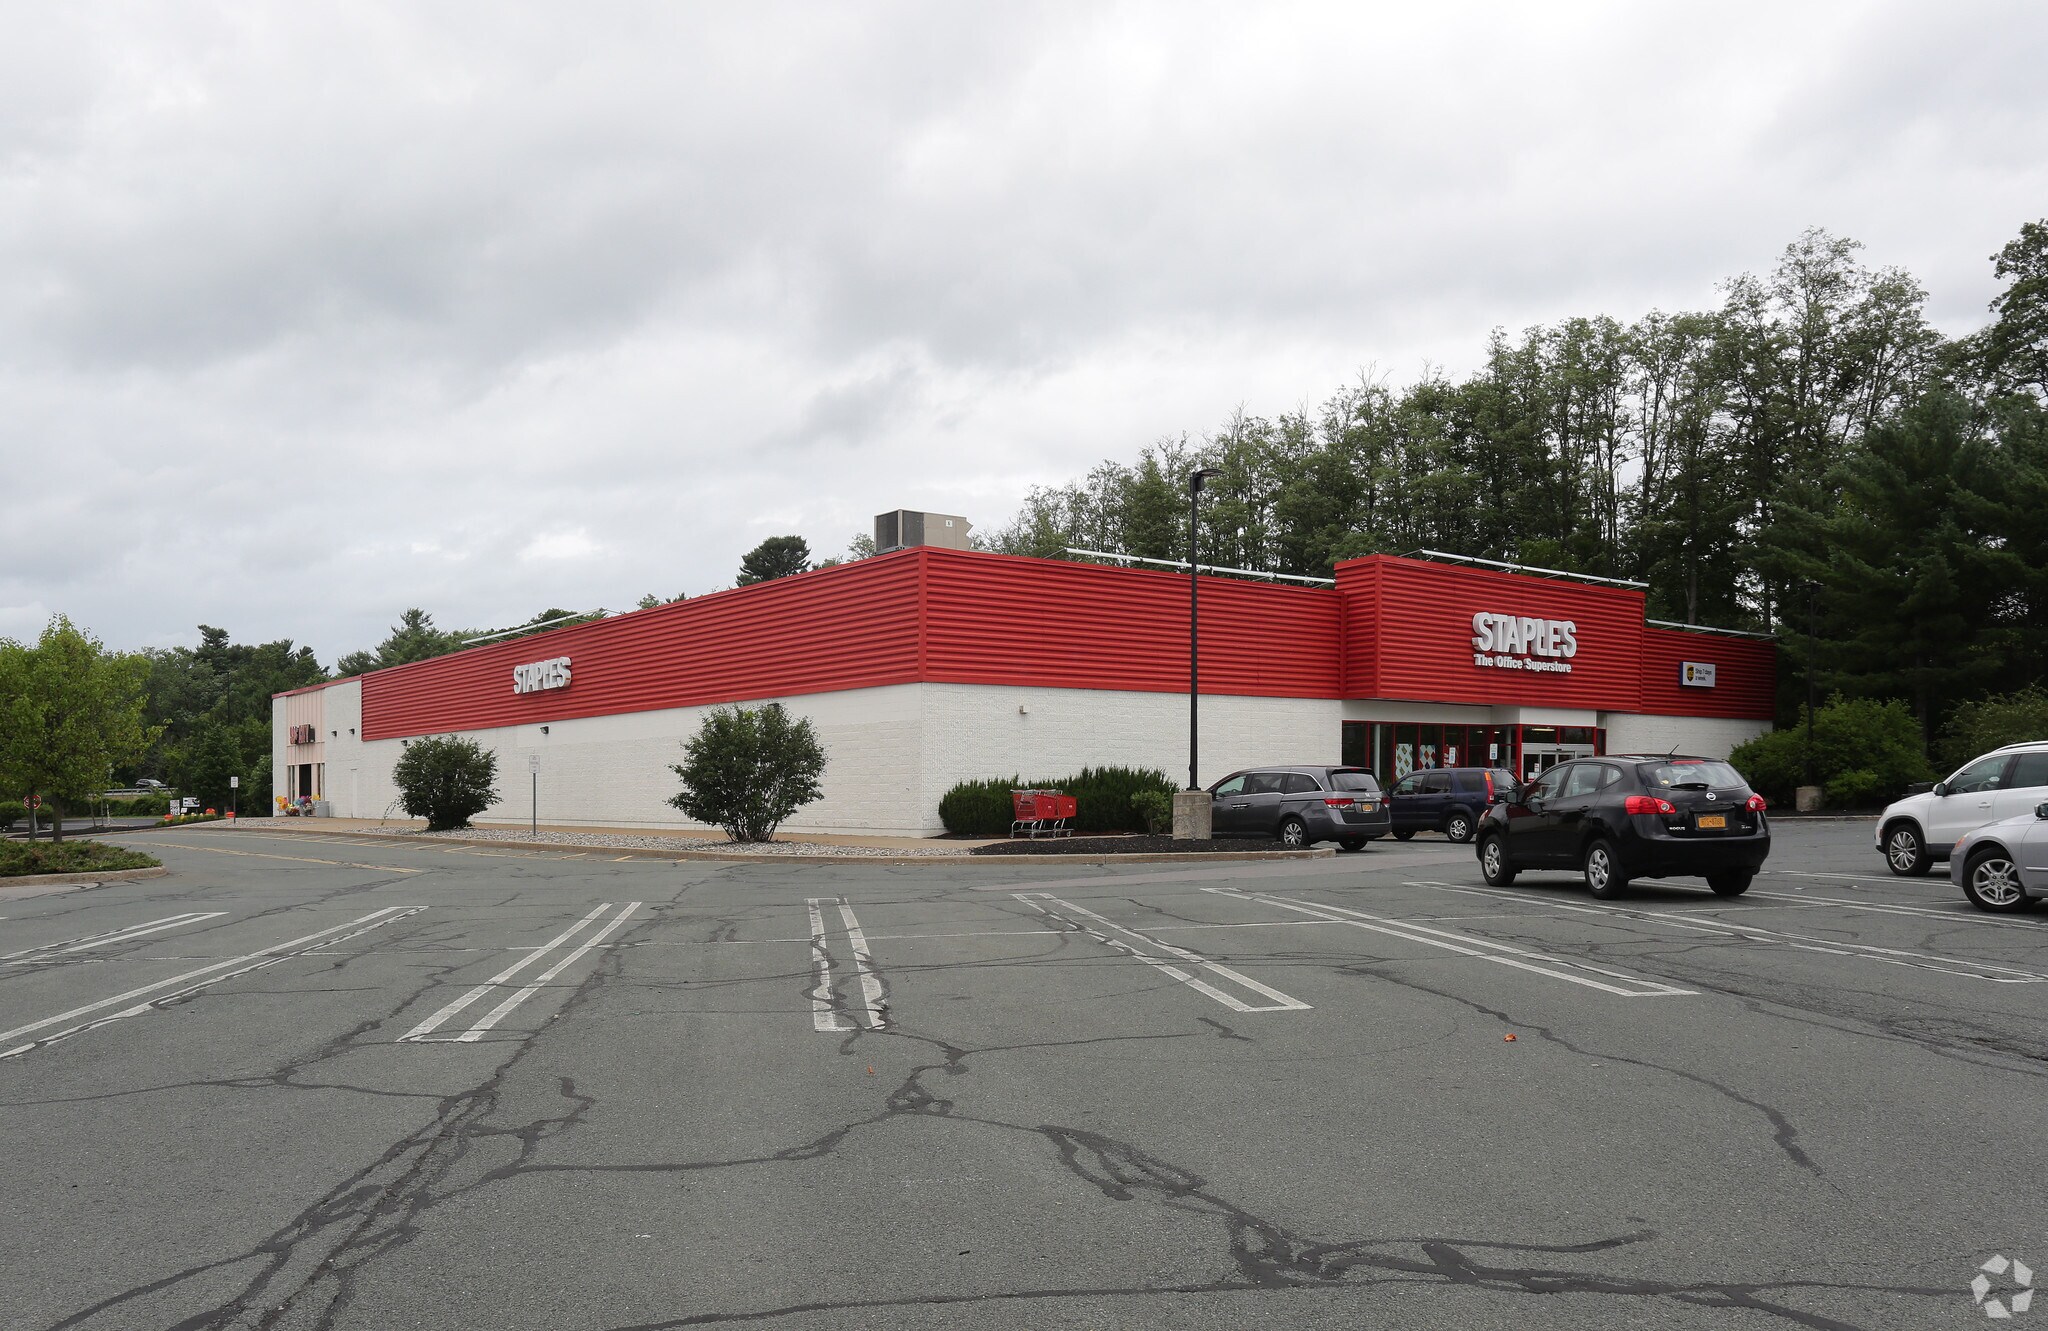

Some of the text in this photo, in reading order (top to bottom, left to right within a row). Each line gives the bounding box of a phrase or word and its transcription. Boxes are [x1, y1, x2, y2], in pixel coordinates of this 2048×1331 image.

[1472, 612, 1577, 658] STAPLES
[514, 656, 571, 694] STAPLES
[1474, 654, 1572, 673] The Office Superstore
